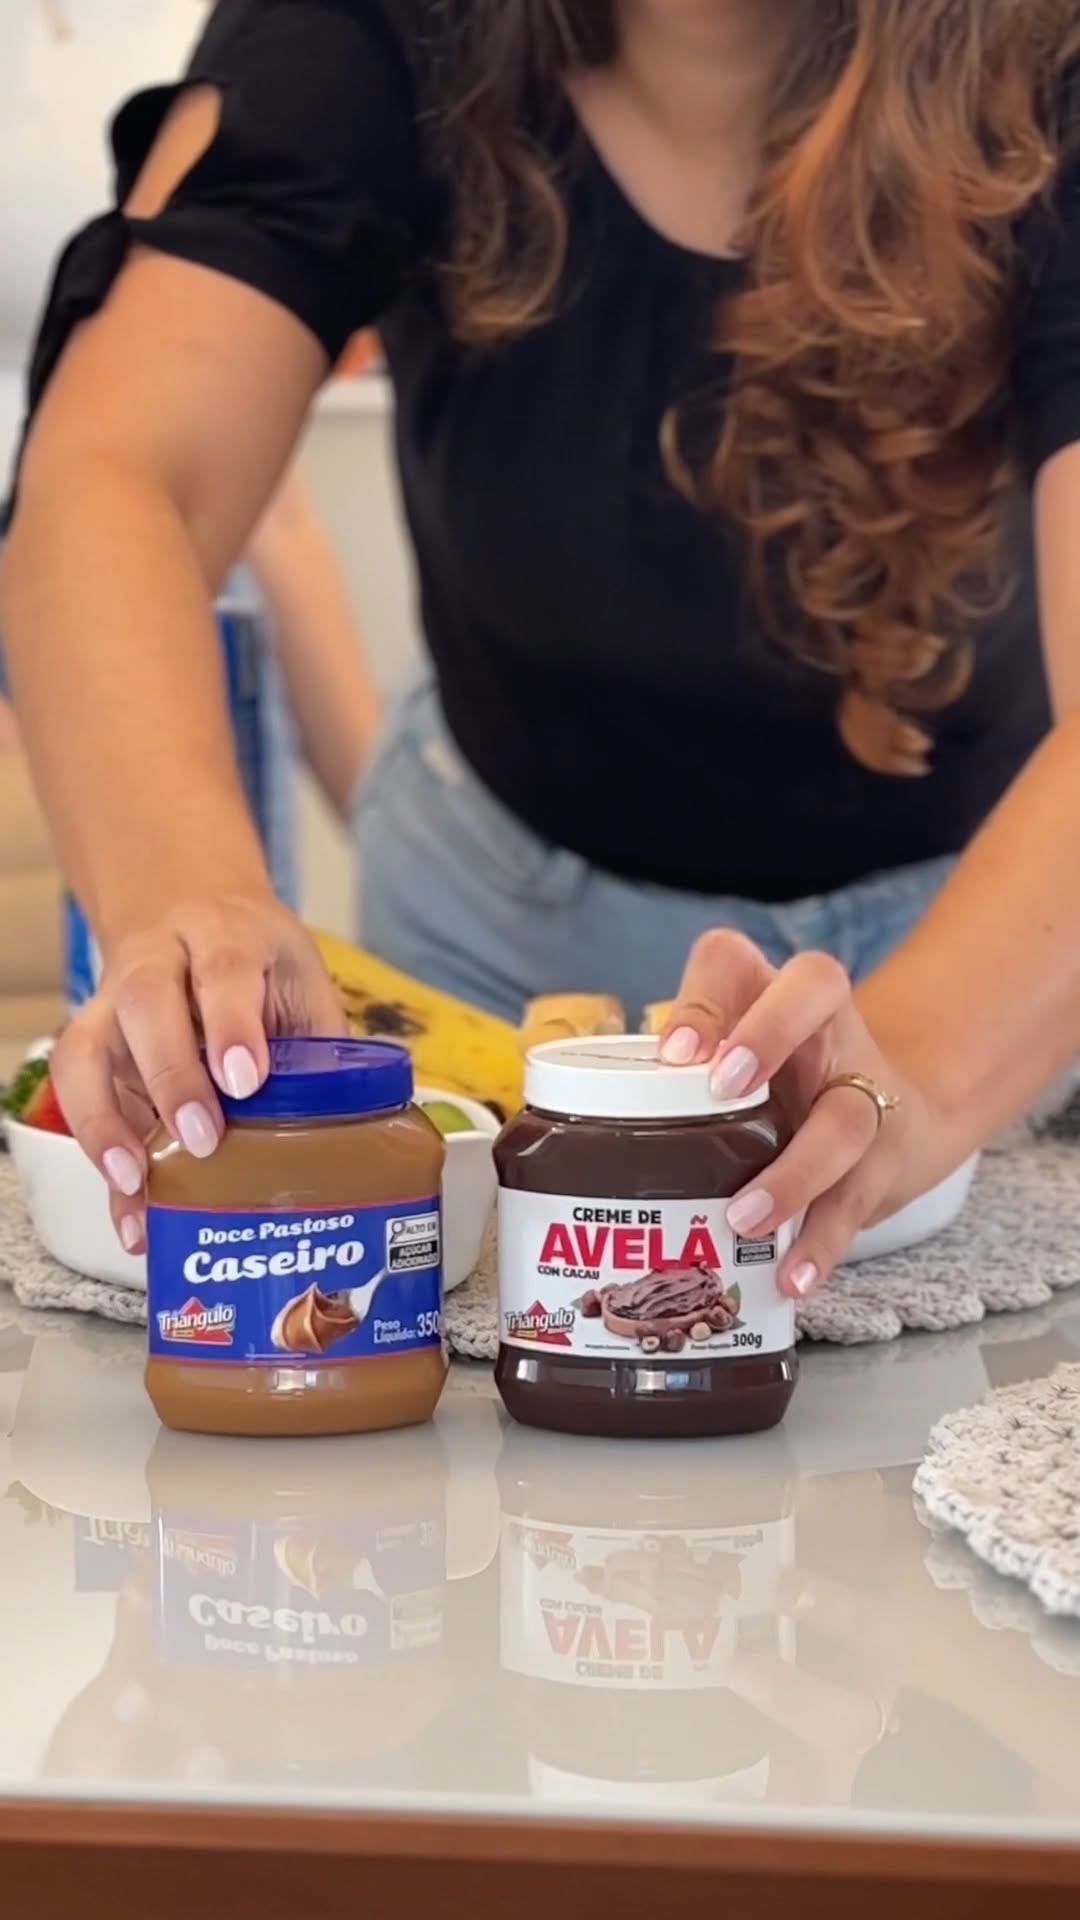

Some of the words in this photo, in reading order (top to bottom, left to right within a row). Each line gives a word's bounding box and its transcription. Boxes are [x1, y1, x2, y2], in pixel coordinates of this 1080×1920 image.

[198, 1227, 256, 1245] Doce
[259, 1214, 355, 1240] Pastoso
[573, 1207, 632, 1224] CREME
[638, 1210, 662, 1224] DE
[539, 1215, 721, 1270] AVELÃ
[183, 1239, 365, 1284] Caseiro
[732, 1332, 763, 1347] 300g
